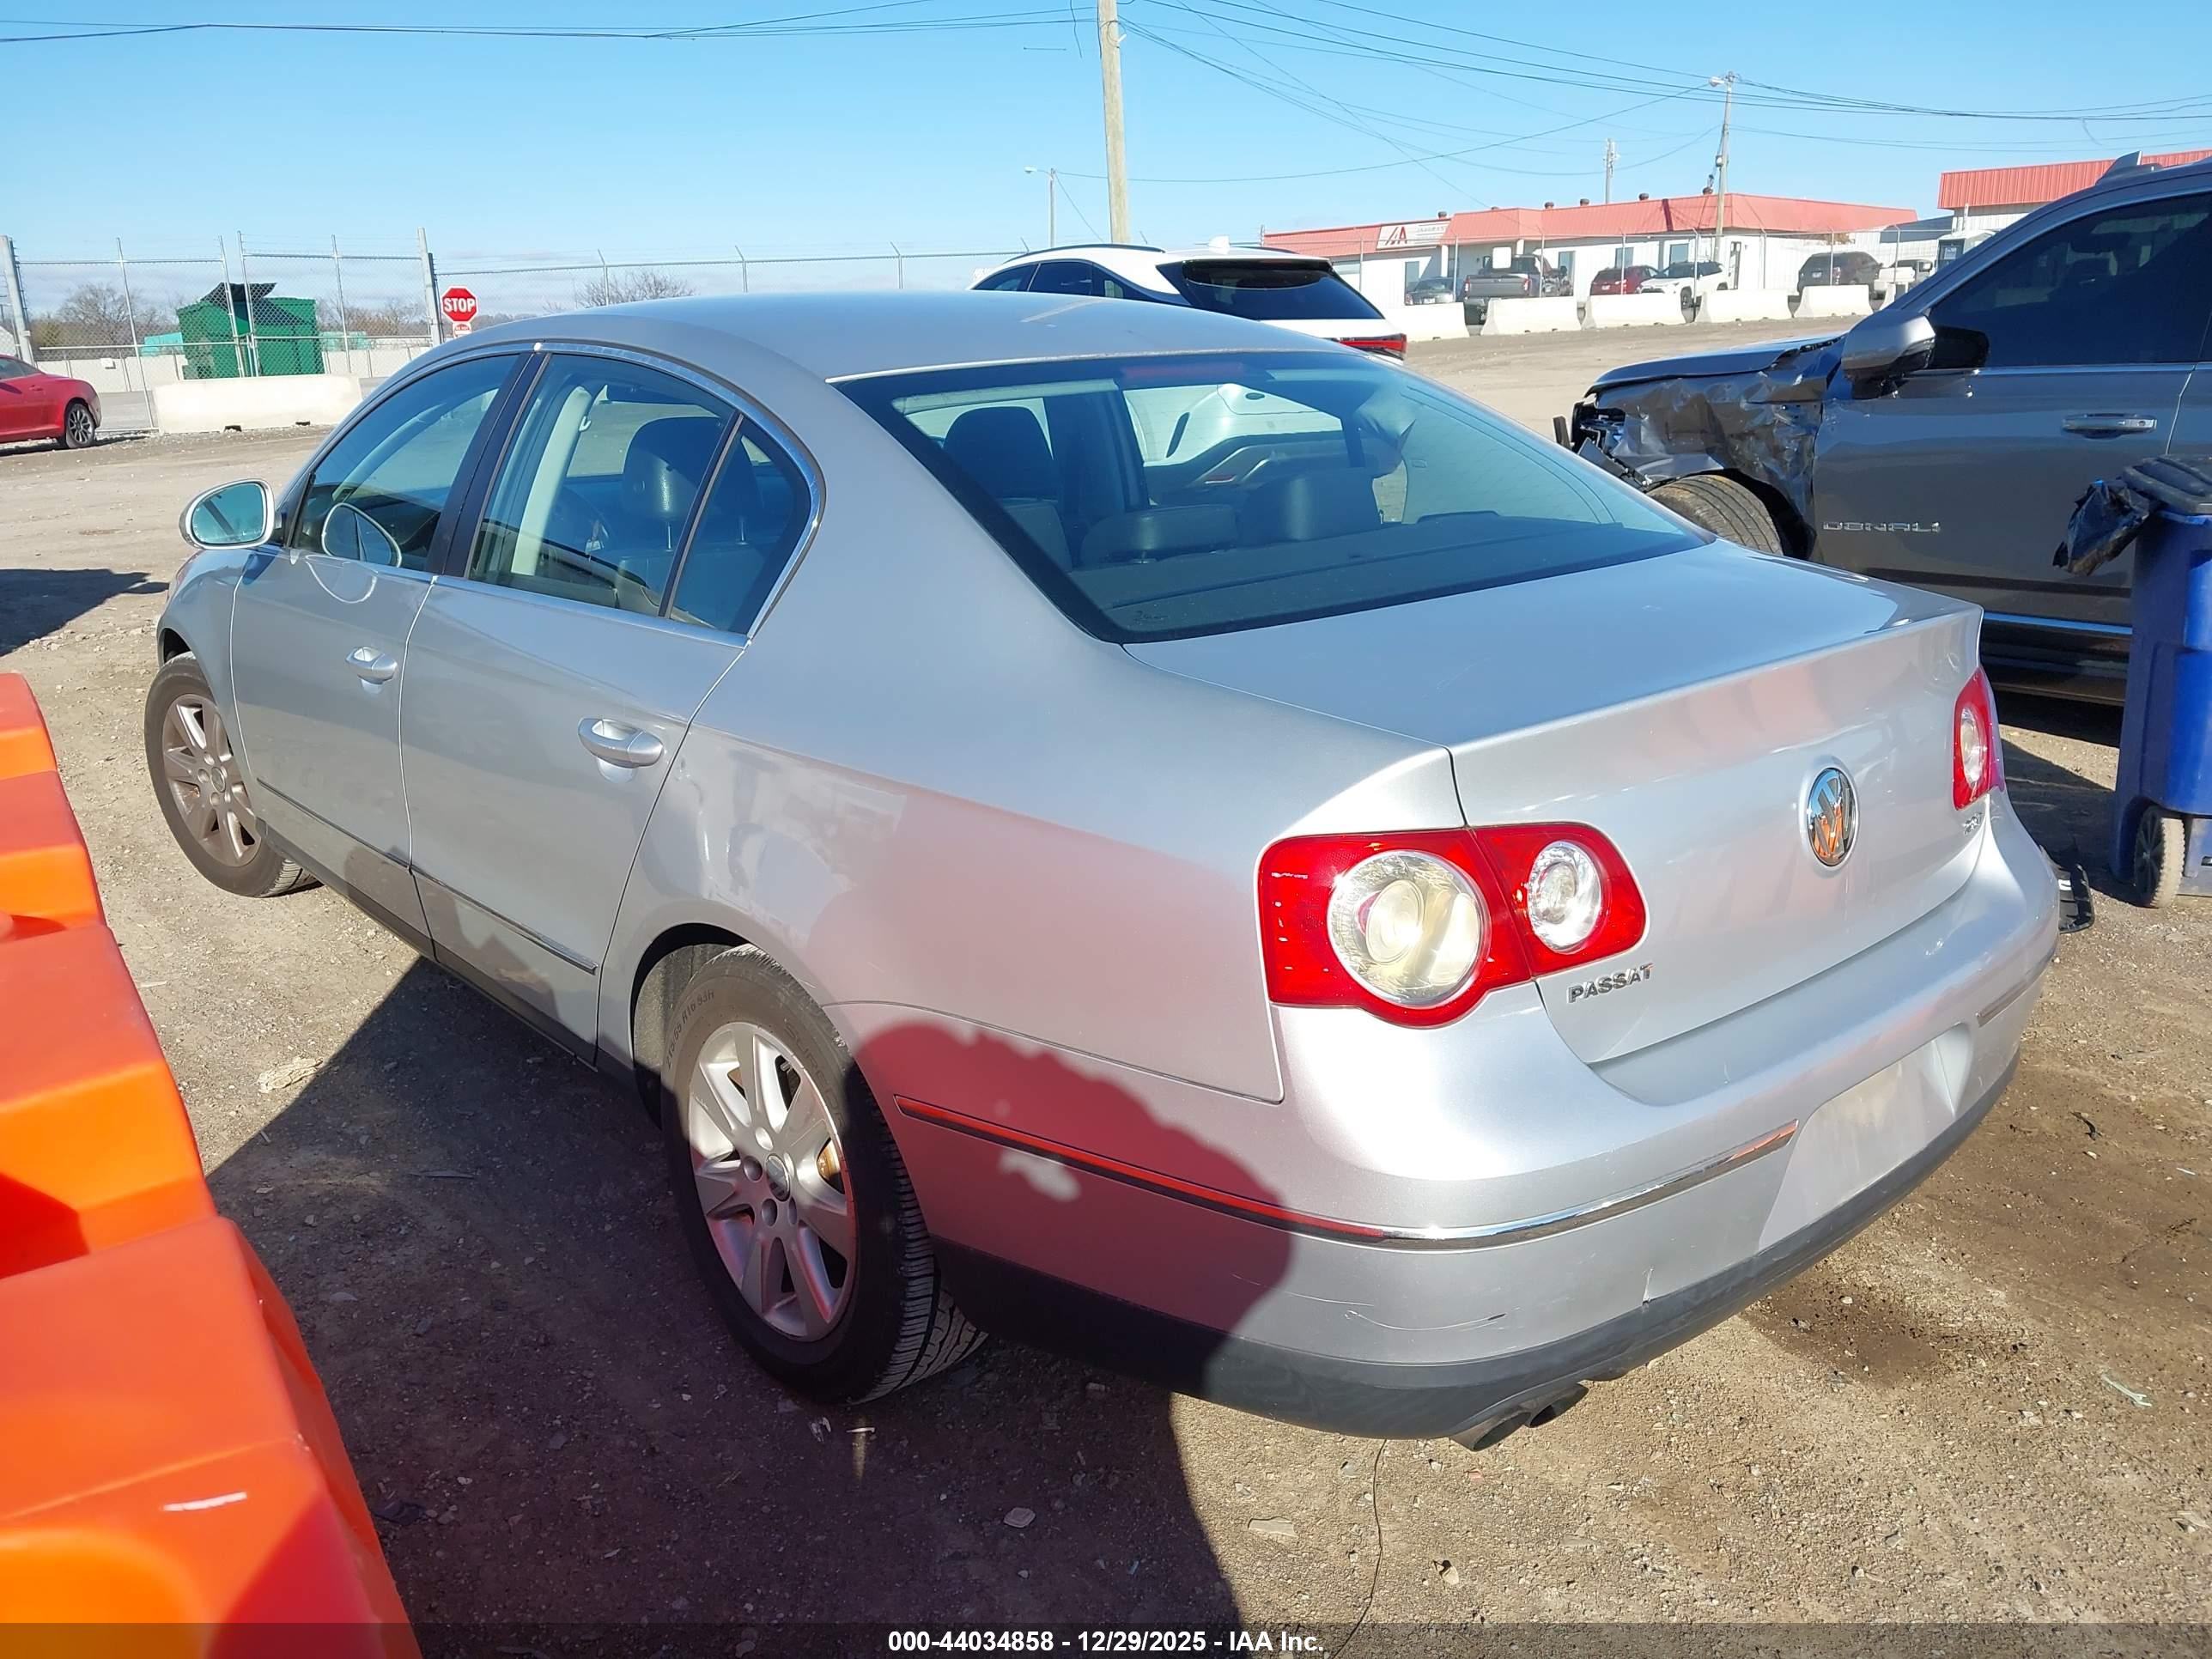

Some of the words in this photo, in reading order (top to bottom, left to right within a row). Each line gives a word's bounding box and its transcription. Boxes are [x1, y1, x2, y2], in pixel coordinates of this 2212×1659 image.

[443, 297, 476, 313] STOP
[1823, 521, 1941, 532] DENALI
[1567, 962, 1655, 1004] PASSAT
